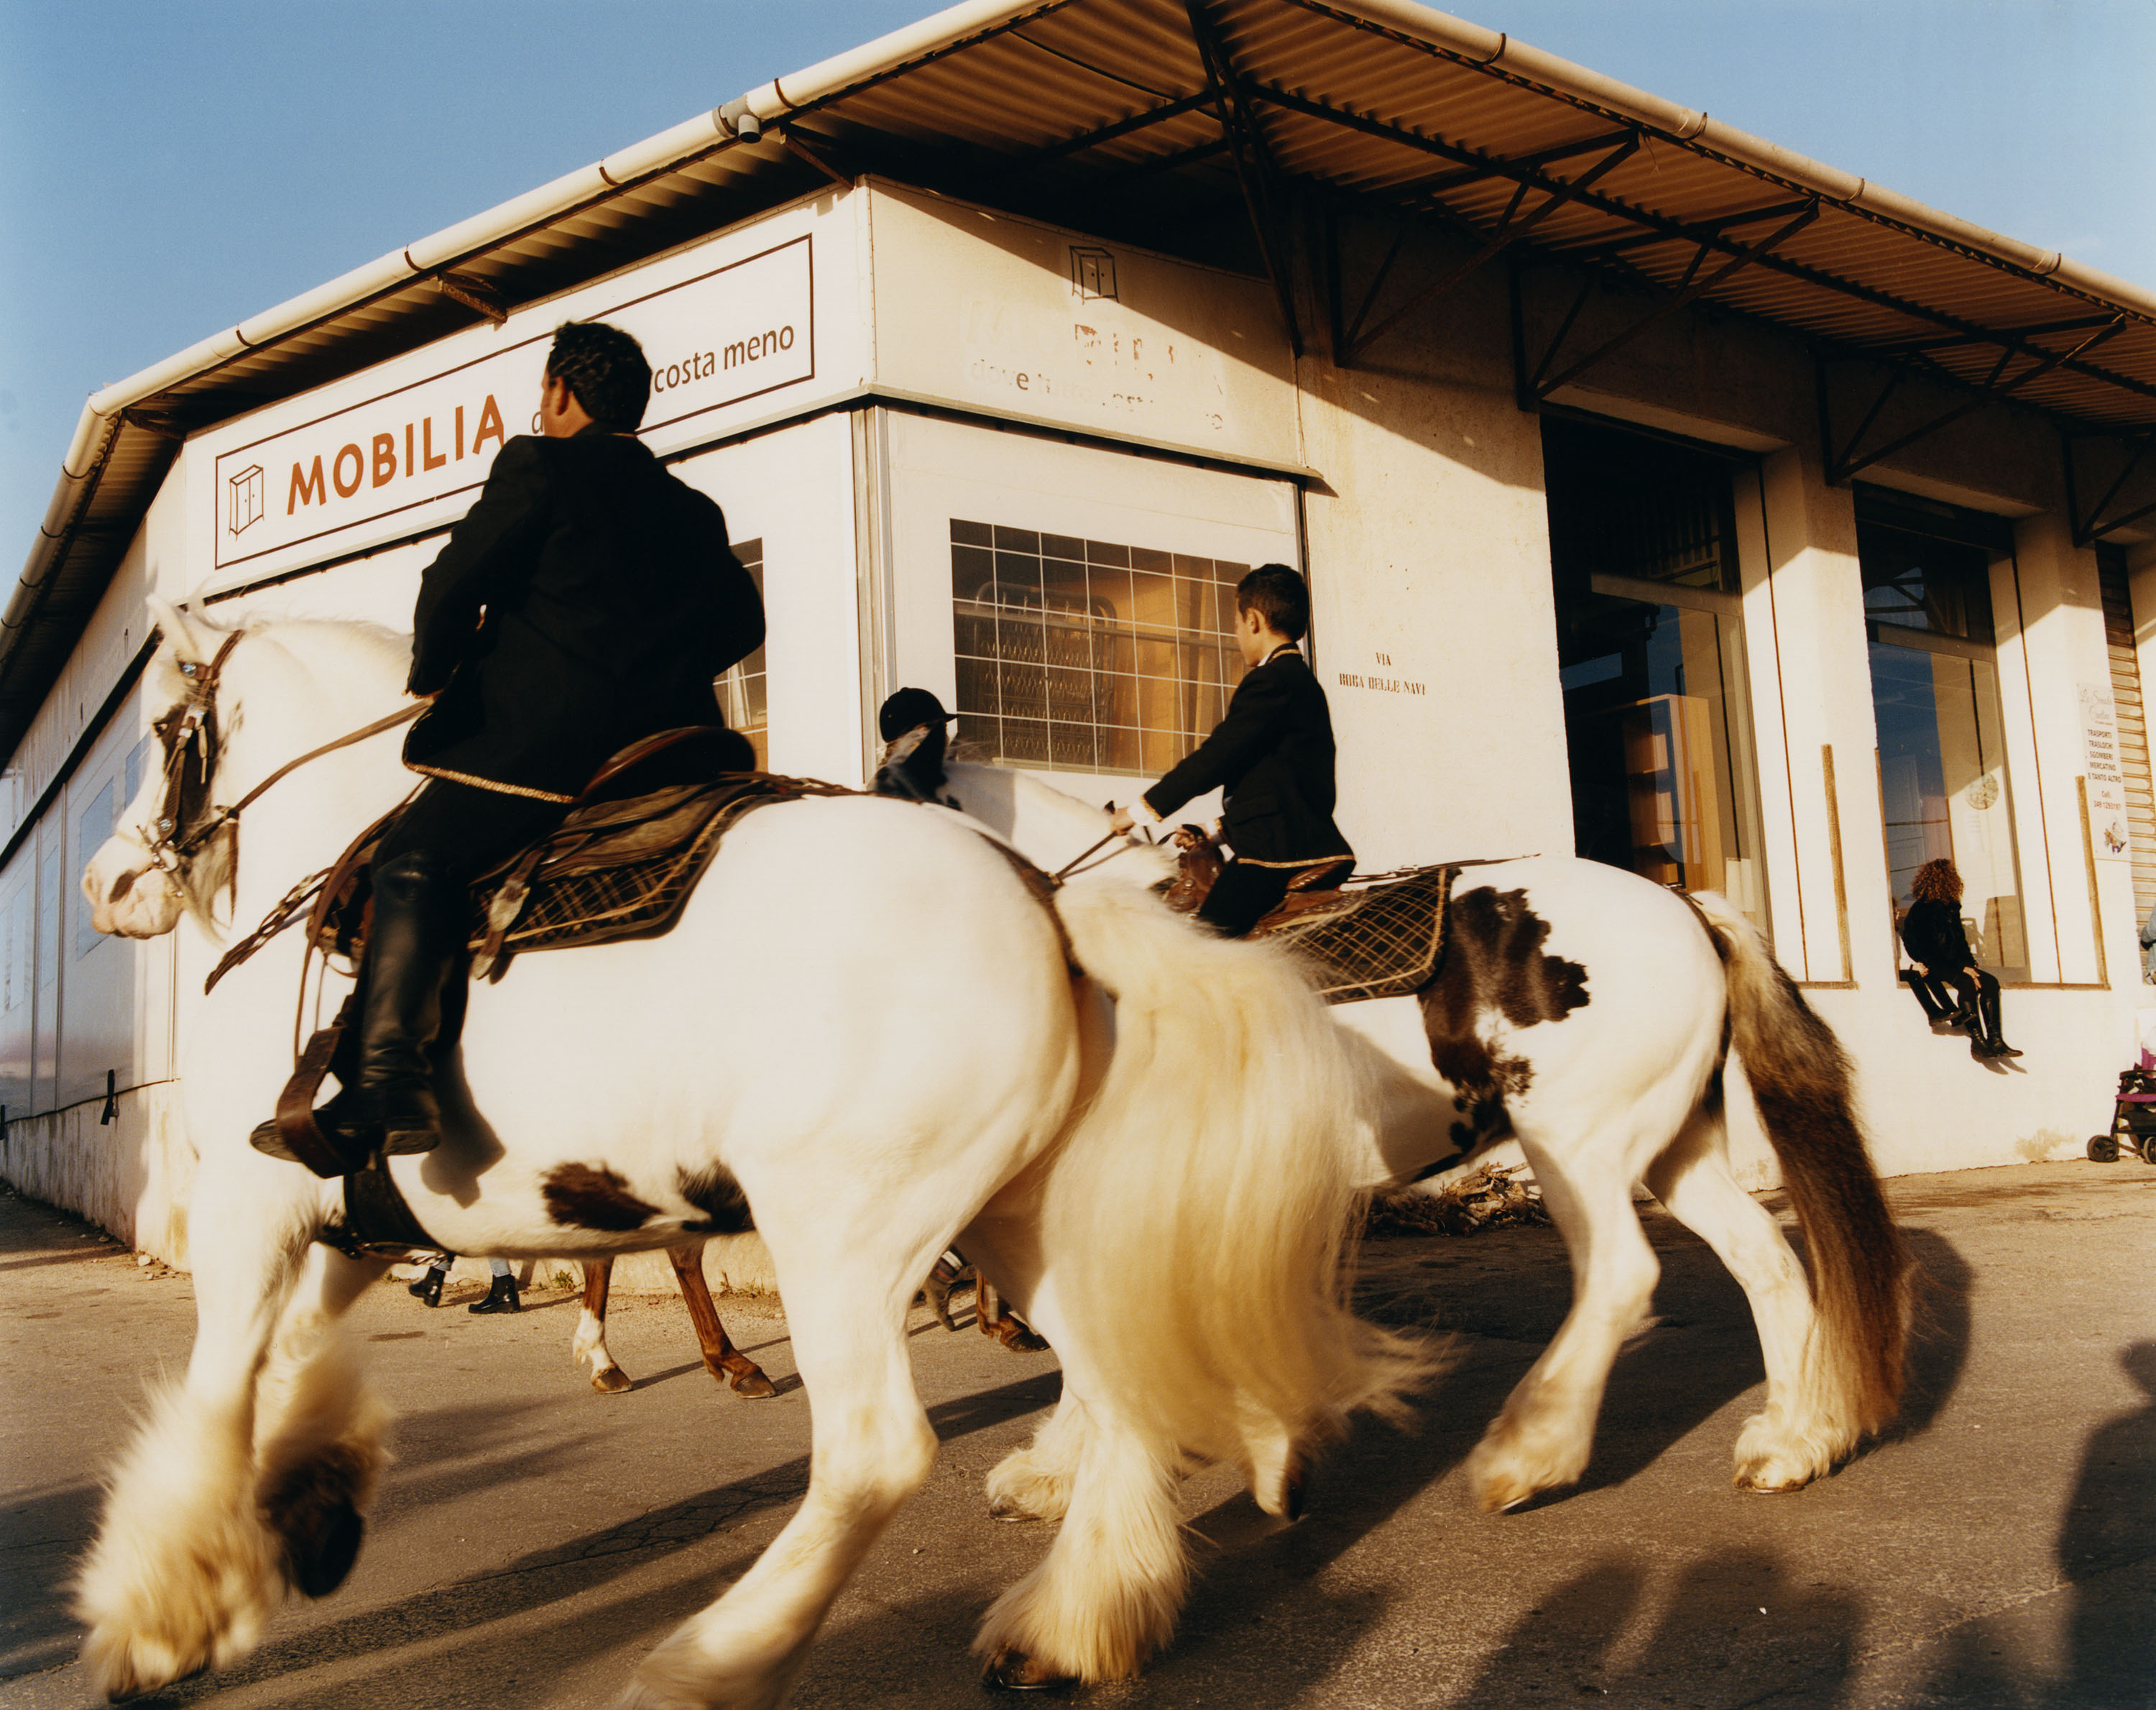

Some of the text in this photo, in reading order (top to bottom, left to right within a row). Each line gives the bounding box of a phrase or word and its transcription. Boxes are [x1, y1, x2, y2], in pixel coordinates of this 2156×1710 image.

[723, 324, 795, 371] meno
[287, 394, 505, 515] MOBILIA
[1376, 652, 1391, 666] VIA
[1368, 677, 1401, 693] DELLE
[1404, 681, 1425, 695] NAVI
[2088, 729, 2112, 739] TRASPORTI
[2088, 740, 2113, 749] TRASLOCHI
[2090, 751, 2113, 760] SGOMBERI
[2089, 762, 2116, 771] MERCATINO
[2092, 773, 2106, 781] TANTO
